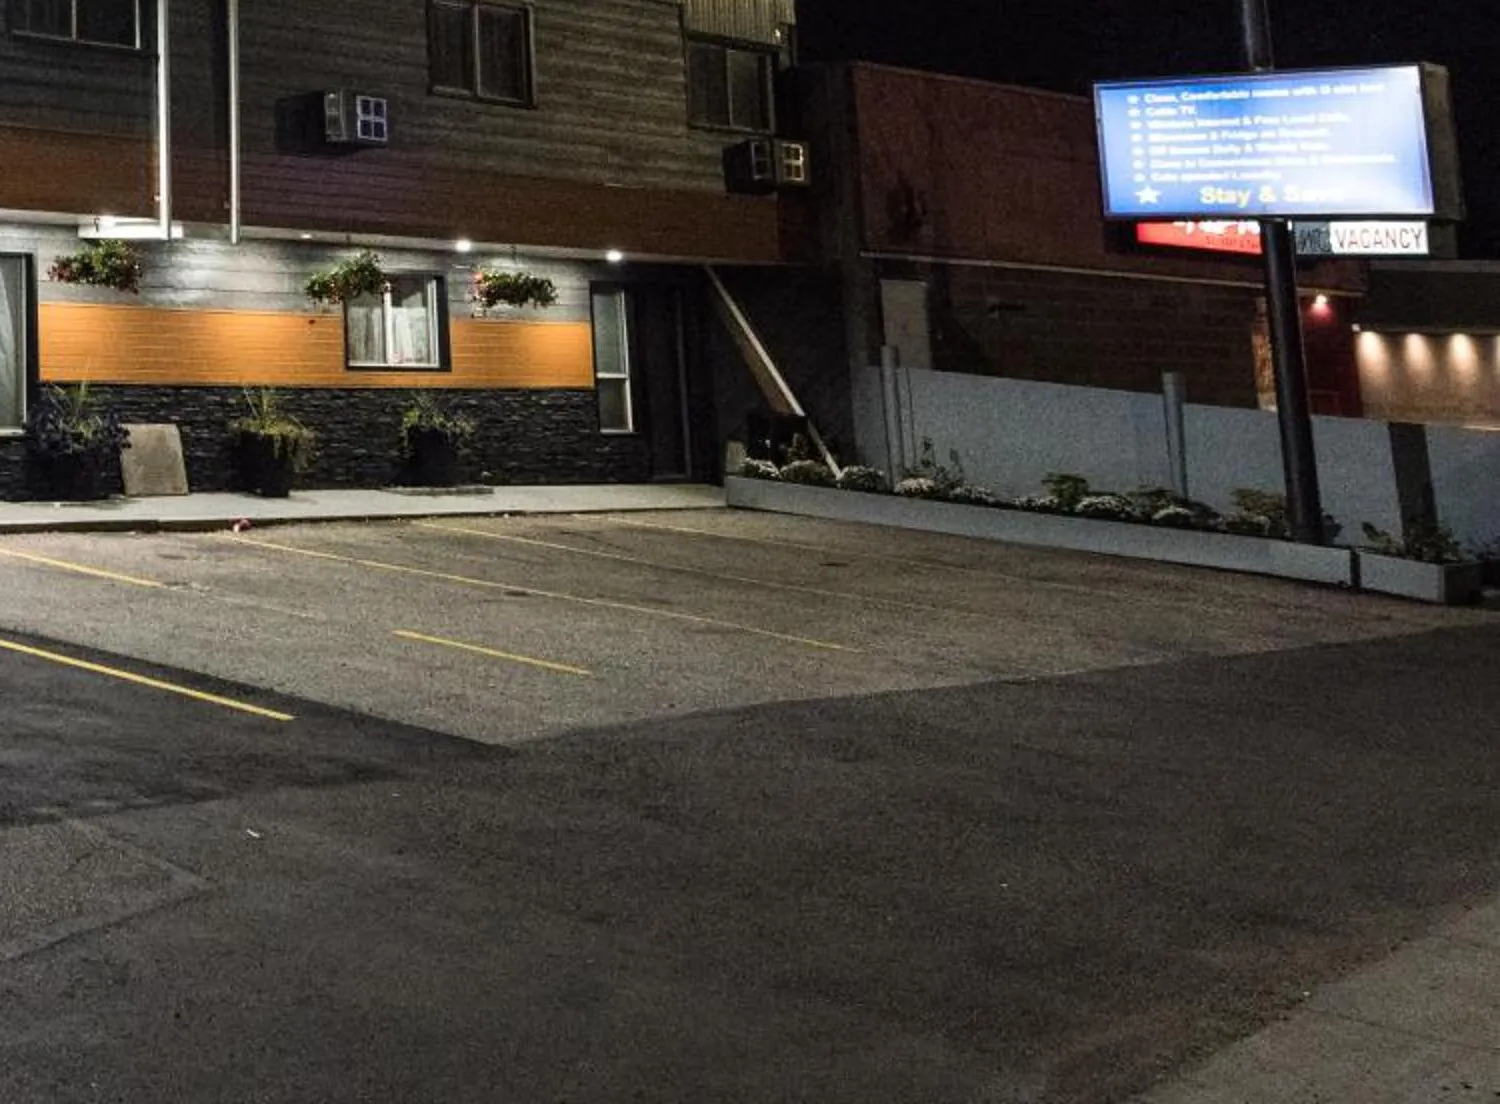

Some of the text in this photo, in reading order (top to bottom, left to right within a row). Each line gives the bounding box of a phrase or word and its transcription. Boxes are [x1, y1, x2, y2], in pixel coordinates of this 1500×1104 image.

[1199, 185, 1250, 208] Stay
[1259, 184, 1276, 203] &
[1334, 226, 1424, 251] VACANCY
